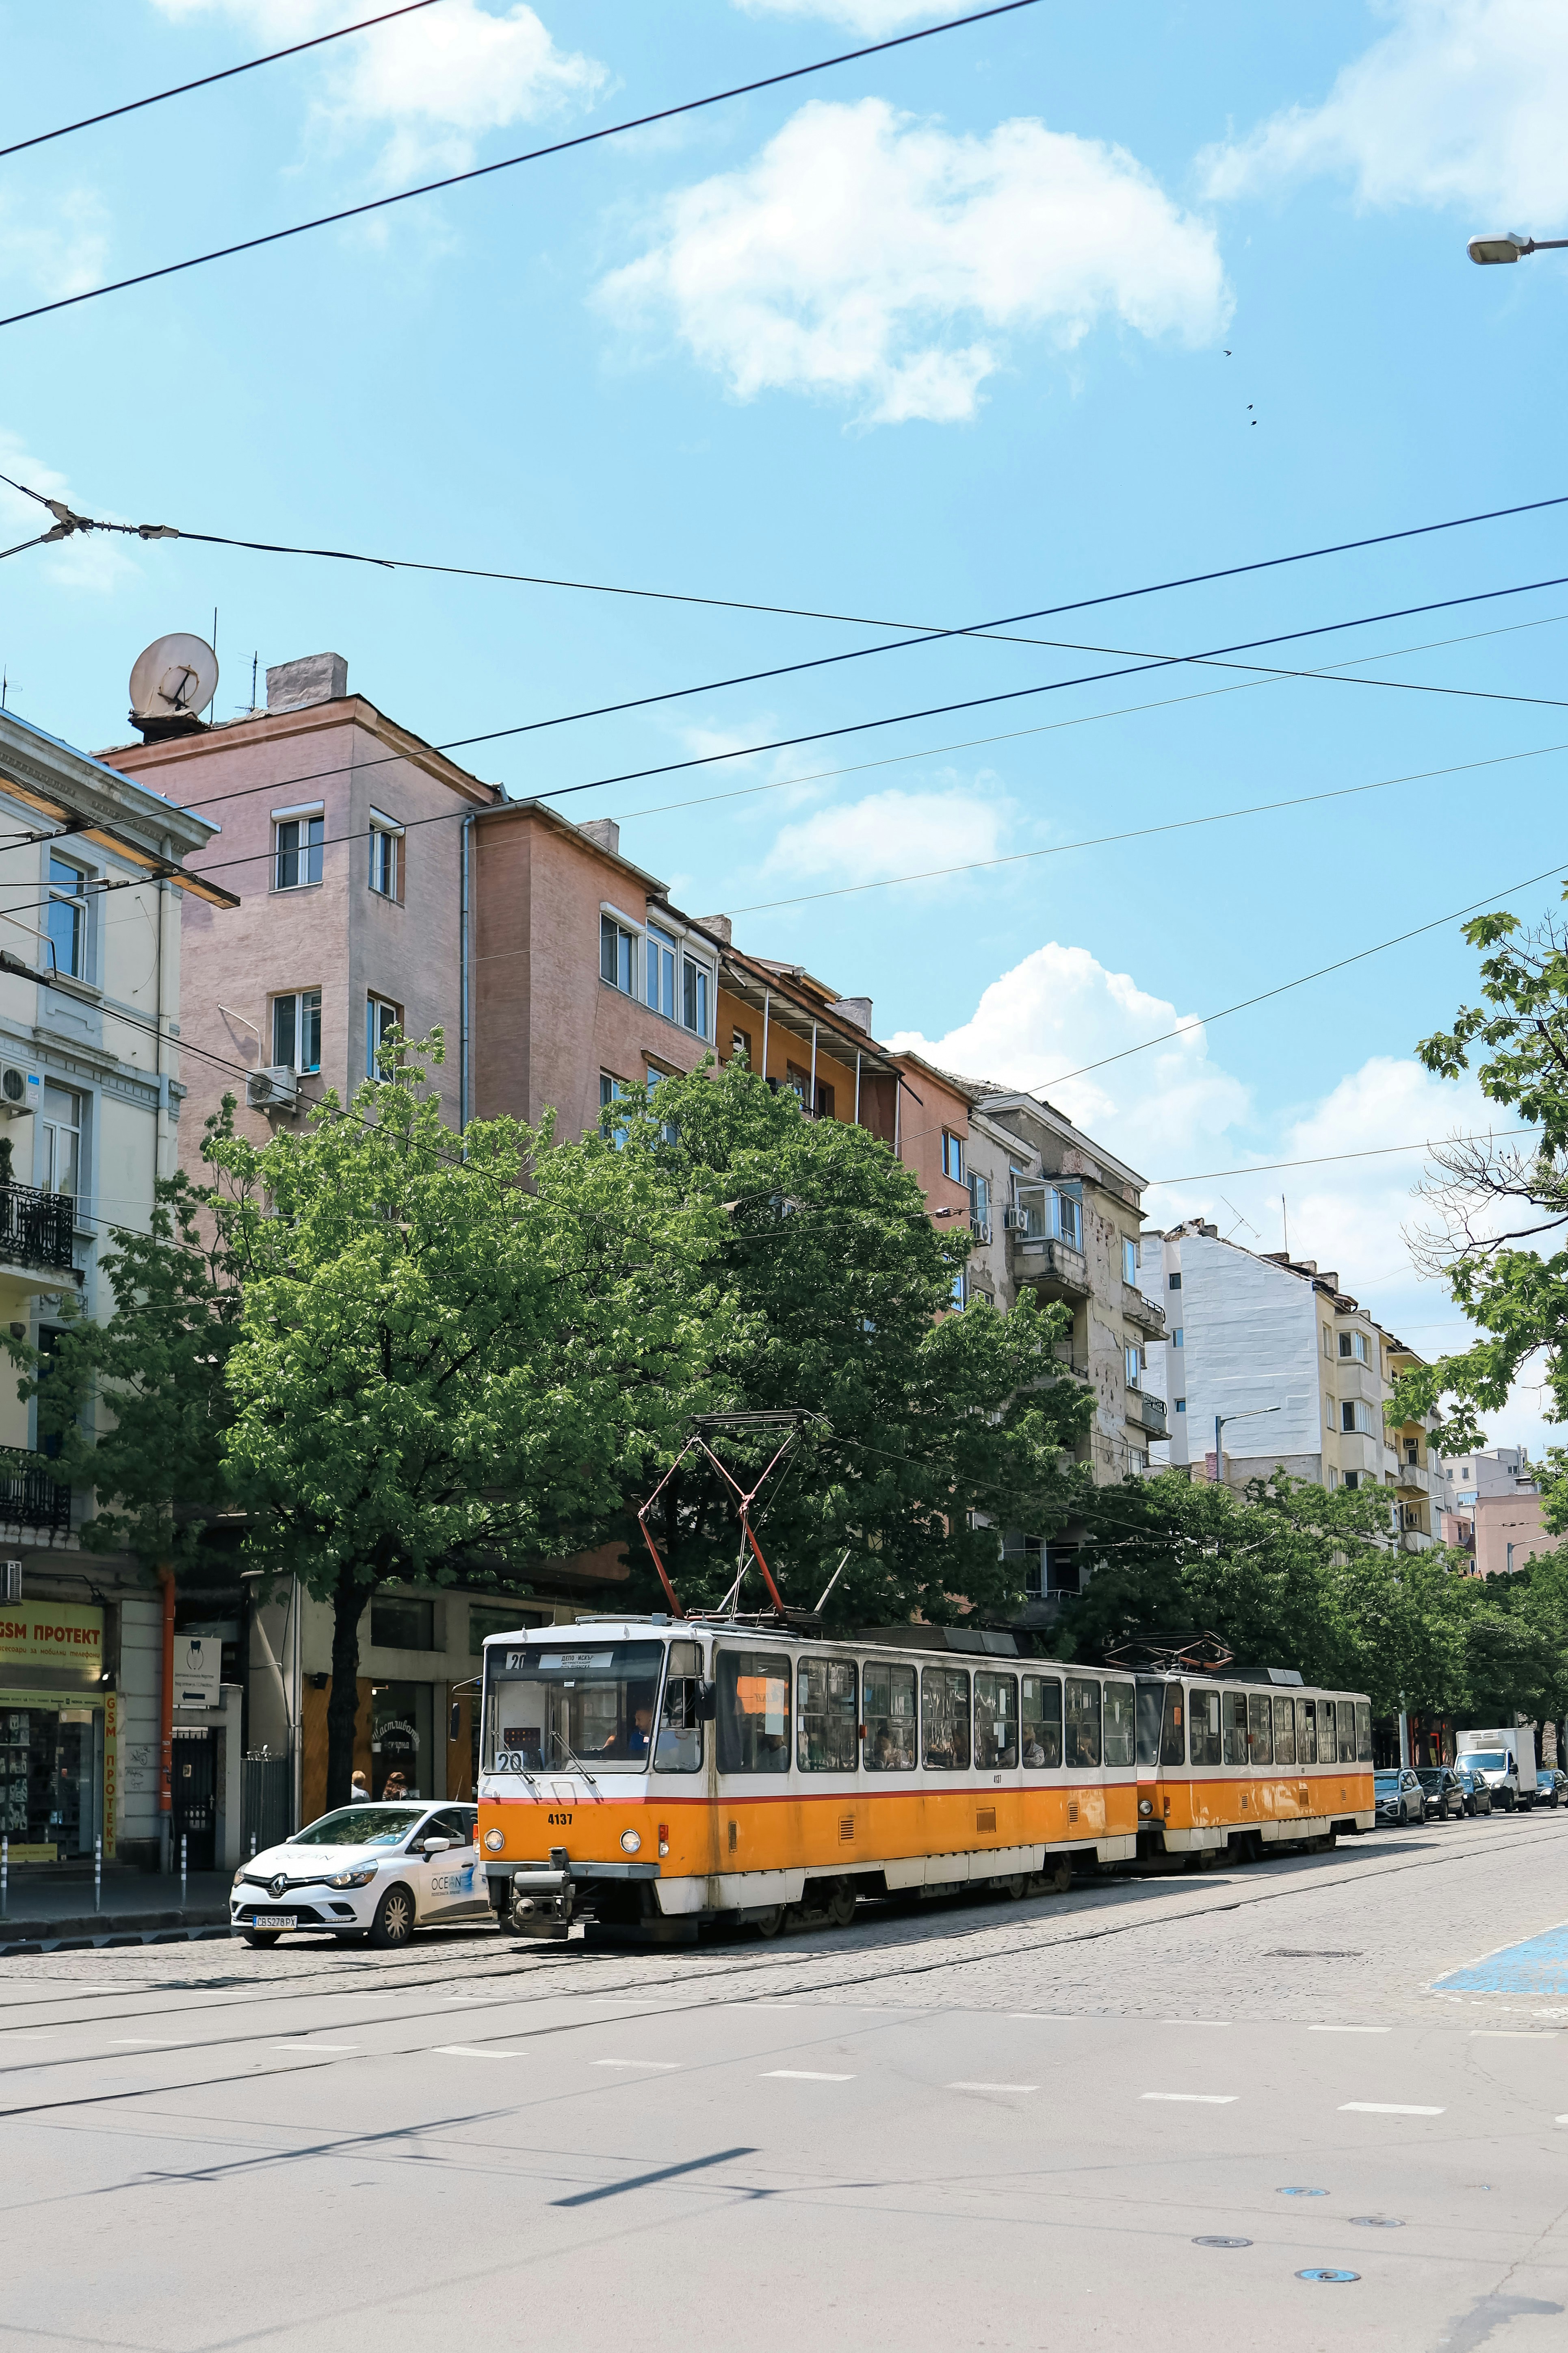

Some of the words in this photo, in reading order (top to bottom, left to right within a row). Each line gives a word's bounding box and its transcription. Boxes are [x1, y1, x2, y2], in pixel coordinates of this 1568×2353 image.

[0, 1622, 26, 1639] GSM
[34, 1625, 100, 1644] ПРОТЕКТ
[106, 1697, 116, 1738] GSM
[498, 1752, 522, 1772] 20
[105, 1755, 115, 1852] ПРОТЕКТ
[548, 1813, 572, 1825] 4137
[431, 1876, 461, 1890] OCEAN
